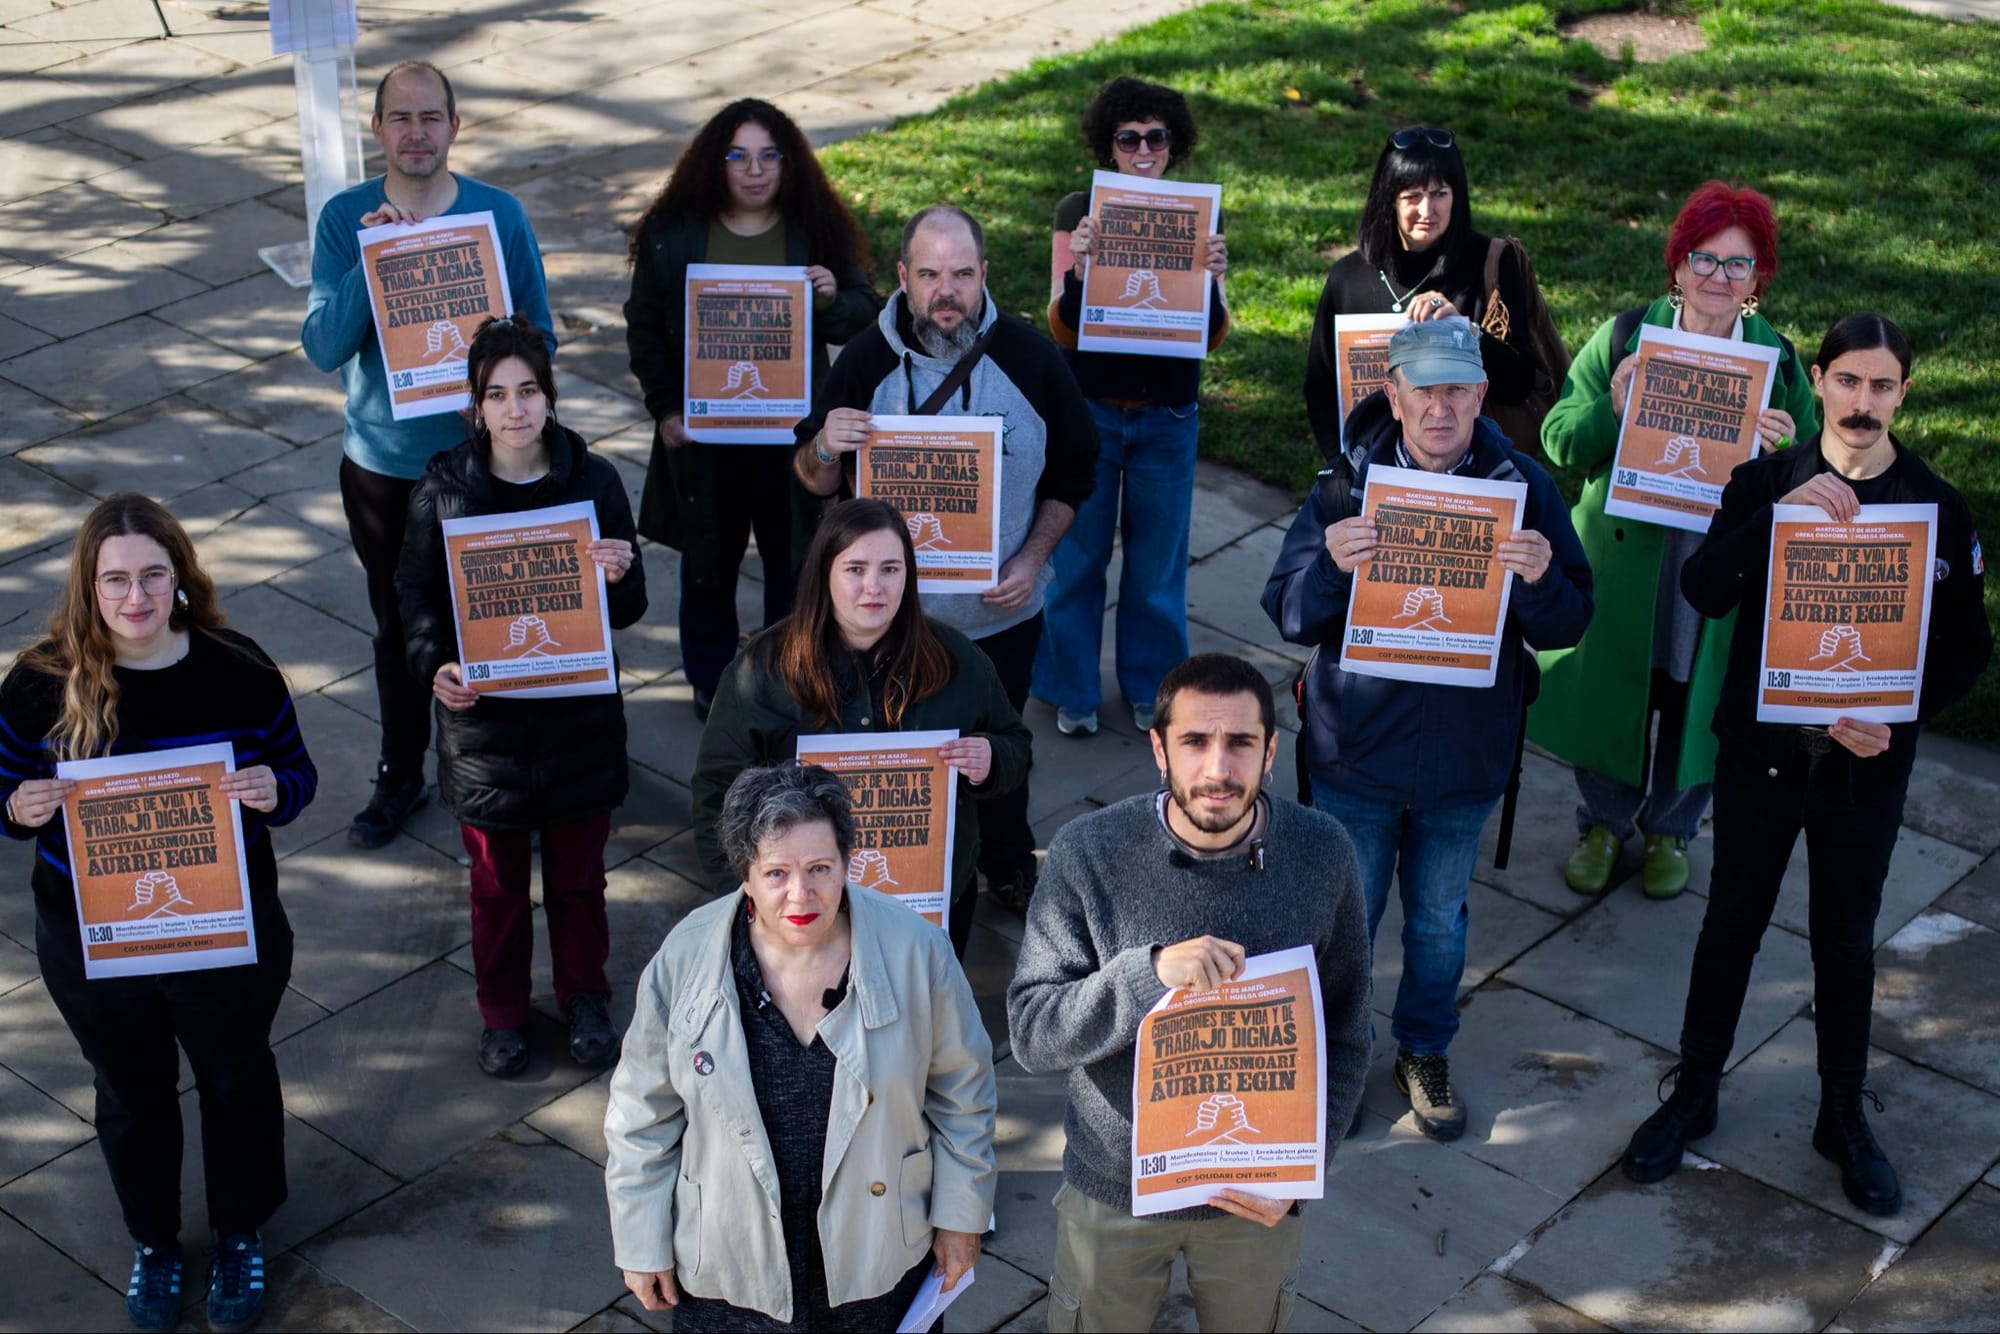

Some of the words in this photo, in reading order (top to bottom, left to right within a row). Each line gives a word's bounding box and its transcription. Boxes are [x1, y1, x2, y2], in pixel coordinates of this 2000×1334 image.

[426, 254, 438, 267] DE
[439, 250, 460, 265] VIDA
[462, 248, 468, 260] Y
[469, 246, 479, 260] DE
[379, 269, 436, 292] TRABAJO
[437, 259, 483, 283] DIGNAS
[385, 283, 486, 310] KAPITALISMOARI
[386, 303, 447, 327] AURRE
[448, 296, 490, 318] EGIN
[393, 372, 414, 388] 11:30
[1696, 372, 1708, 385] DE
[1709, 375, 1730, 389] VIDA
[1732, 379, 1738, 390] Y
[1739, 380, 1750, 392] DE
[1643, 374, 1699, 400] TRABAJO
[1701, 387, 1748, 410] DIGNAS
[1640, 397, 1742, 426] KAPITALISMOARI
[1635, 409, 1697, 436] AURRE
[1697, 422, 1740, 444] EGIN
[923, 453, 934, 464] DE
[937, 454, 958, 464] VIDA
[961, 454, 966, 465] Y
[968, 455, 978, 465] DE
[871, 463, 927, 480] TRABAJO
[932, 466, 979, 481] DIGNAS
[1617, 470, 1638, 487] 11:30
[871, 484, 977, 497] KAPITALISMOARI
[935, 498, 978, 513] EGIN
[1374, 511, 1432, 529] CONDICIONES
[1434, 517, 1447, 531] DE
[1449, 519, 1473, 533] VIDA
[1475, 522, 1482, 534] Y
[1484, 523, 1495, 536] DE
[1373, 524, 1437, 548] TRABAJO
[1441, 532, 1494, 552] DIGNAS
[518, 549, 530, 562] DE
[532, 546, 555, 560] VIDA
[558, 546, 564, 557] Y
[566, 544, 576, 557] DE
[1784, 547, 1844, 562] CONDICIONES
[1847, 549, 1859, 562] DE
[1862, 549, 1886, 562] VIDA
[1889, 549, 1896, 562] Y
[1898, 549, 1909, 562] DE
[464, 564, 525, 584] TRABAJO
[528, 556, 580, 578] DIGNAS
[1366, 563, 1437, 586] AURRE
[1439, 569, 1487, 589] EGIN
[1784, 562, 1850, 582] TRABAJO
[1855, 564, 1909, 582] DIGNAS
[467, 579, 581, 602] KAPITALISMOARI
[1783, 589, 1906, 602] KAPITALISMOARI
[467, 598, 534, 619] AURRE
[536, 592, 584, 613] EGIN
[1780, 604, 1852, 623] AURRE
[1855, 605, 1905, 623] EGIN
[1351, 628, 1374, 645] 11:30
[468, 664, 491, 679] 11:30
[1768, 672, 1791, 688] 11:30
[870, 775, 882, 787] DE
[886, 773, 908, 788] VIDA
[912, 774, 917, 786] Y
[921, 773, 930, 786] DE
[143, 797, 157, 811] DE
[160, 793, 186, 809] VIDA
[188, 792, 196, 805] Y
[197, 790, 210, 805] DE
[878, 788, 931, 808] DIGNAS
[82, 813, 152, 837] TRABAJO
[155, 804, 214, 829] DIGNAS
[86, 831, 216, 856] KAPITALISMOARI
[881, 828, 929, 848] EGIN
[86, 851, 163, 876] AURRE
[164, 845, 219, 869] EGIN
[88, 926, 114, 943] 11:30
[1152, 1012, 1216, 1039] CONDICIONES
[1221, 1011, 1236, 1026] DE
[1241, 1009, 1268, 1026] VIDA
[1272, 1008, 1278, 1023] Y
[1282, 1005, 1294, 1022] DE
[1153, 1028, 1226, 1058] TRABAJO
[1232, 1023, 1296, 1048] DIGNAS
[1152, 1054, 1296, 1080] KAPITALISMOARI
[1151, 1072, 1232, 1102] AURRE
[1236, 1071, 1296, 1092] EGIN
[1141, 1155, 1166, 1176] 11:30
